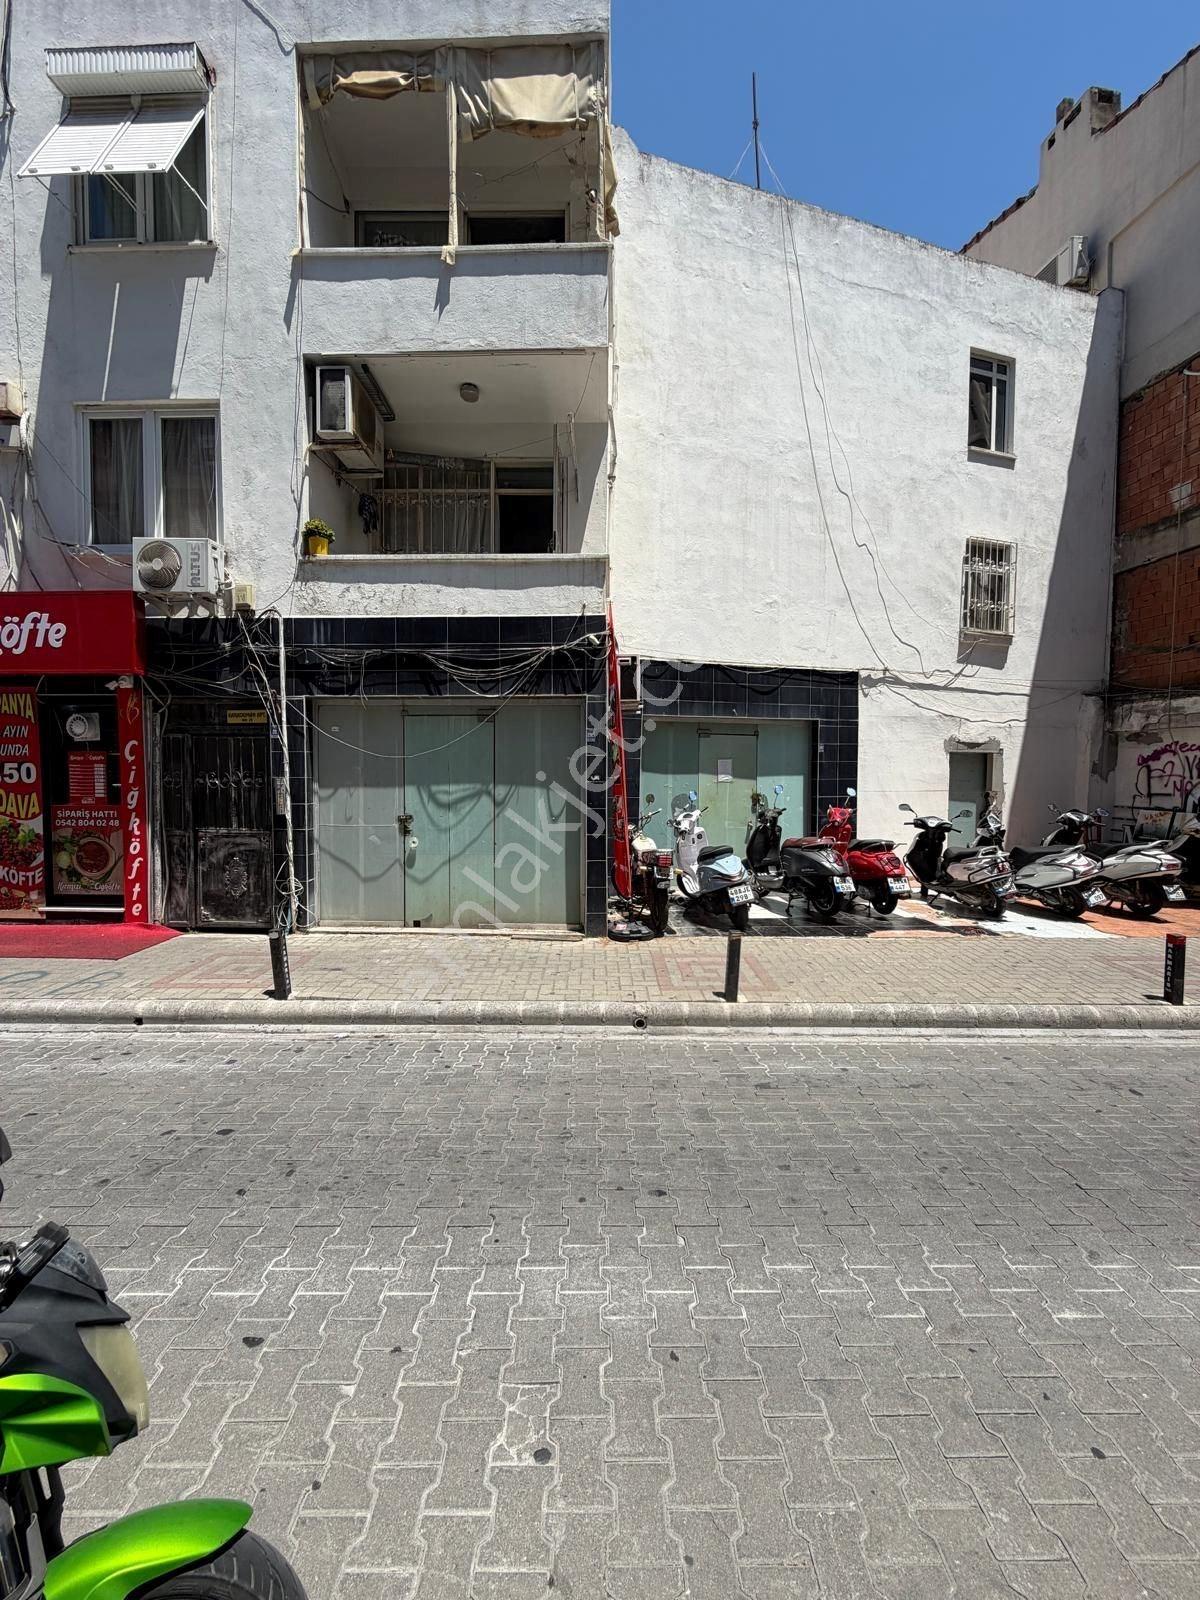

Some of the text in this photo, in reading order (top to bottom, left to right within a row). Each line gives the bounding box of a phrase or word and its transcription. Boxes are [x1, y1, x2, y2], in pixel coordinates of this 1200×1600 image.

[189, 542, 202, 587] ALTUS
[0, 611, 67, 655] öfte
[0, 692, 35, 724] ANYA
[3, 725, 29, 738] AYIN
[55, 819, 77, 827] 0542
[96, 819, 107, 827] 02
[108, 819, 120, 827] 48
[123, 739, 144, 917] Çiğköfte
[735, 893, 749, 902] 298
